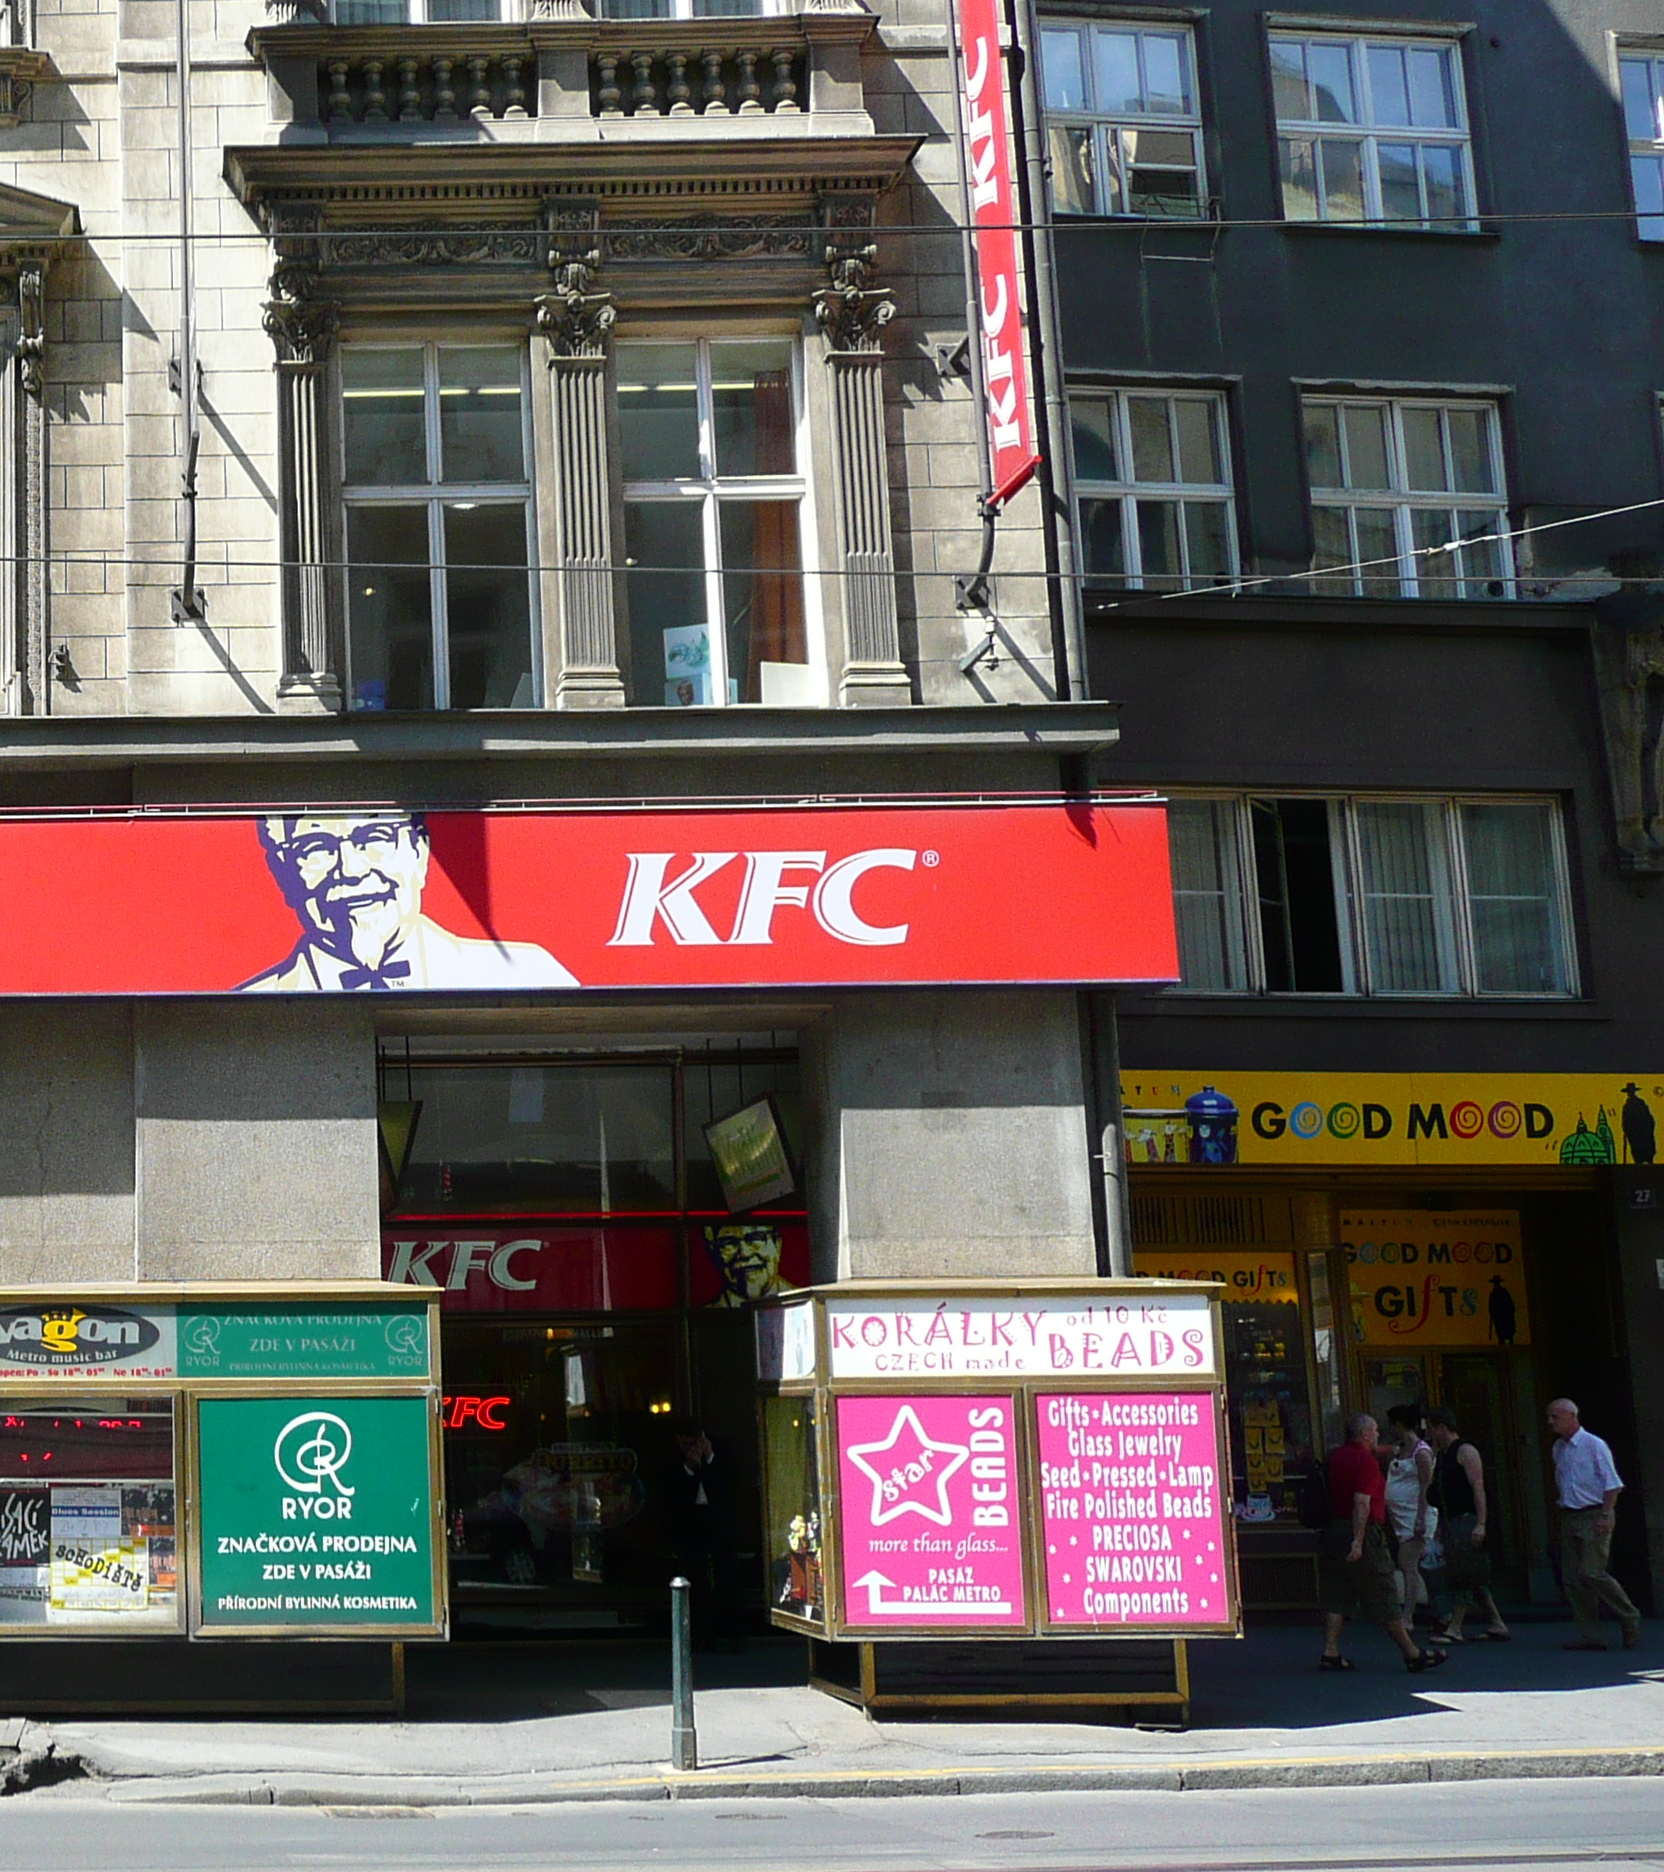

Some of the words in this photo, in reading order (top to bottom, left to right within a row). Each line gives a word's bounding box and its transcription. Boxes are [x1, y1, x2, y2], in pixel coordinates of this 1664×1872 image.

[963, 36, 999, 208] KFC
[980, 273, 1021, 453] KFC
[605, 848, 917, 946] KFC
[1251, 1101, 1393, 1139] GOOD
[1406, 1100, 1554, 1139] MOOD
[1634, 1189, 1651, 1203] 27
[387, 1239, 542, 1291] KFC
[1342, 1241, 1419, 1265] GOOD
[1427, 1241, 1513, 1264] MOOD
[832, 1301, 1048, 1349] KORÁLKY
[1066, 1306, 1093, 1326] od
[1104, 1305, 1130, 1325] 10
[1140, 1303, 1169, 1325] Kč
[7, 1348, 48, 1363] Metro
[51, 1351, 91, 1365] music
[94, 1348, 118, 1363] bar
[249, 1338, 280, 1352] ZDE
[285, 1338, 297, 1352] V
[301, 1335, 356, 1352] PASÁŽI
[1048, 1329, 1205, 1370] BEADS
[26, 1367, 39, 1377] Po
[113, 1367, 127, 1377] Ne
[185, 1356, 220, 1367] RYOR
[387, 1354, 423, 1367] RYOR
[874, 1351, 954, 1372] CZECH
[442, 1396, 511, 1430] FC
[1047, 1399, 1090, 1432] Gifts
[1101, 1397, 1199, 1427] Accessories
[1068, 1430, 1113, 1458] Glass
[1118, 1431, 1183, 1463] Jewelry
[882, 1447, 935, 1502] star
[967, 1406, 1009, 1527] BEADS
[1041, 1461, 1081, 1489] Seed
[1092, 1461, 1156, 1489] Pressed
[1168, 1464, 1214, 1493] Lamp
[52, 1507, 79, 1516] Blues
[80, 1507, 120, 1516] Session
[281, 1496, 352, 1521] RYOR
[1047, 1492, 1079, 1520] Fire
[1084, 1491, 1158, 1520] Polished
[1163, 1491, 1213, 1519] Beads
[217, 1531, 318, 1554] ZNAČKOVÁ
[322, 1535, 418, 1556] PRODEJNA
[868, 1537, 909, 1553] more
[912, 1533, 953, 1553] than
[1092, 1524, 1173, 1552] PRECIOSA
[262, 1564, 295, 1580] ZDE
[299, 1564, 311, 1580] V
[315, 1560, 371, 1580] PASÁŽI
[1085, 1554, 1183, 1583] SWAROVSKI
[217, 1594, 282, 1610] PŘÍRODNÍ
[285, 1594, 341, 1610] BYLINNÁ
[343, 1596, 418, 1610] KOSMETIKA
[953, 1585, 1001, 1602] METRO
[1083, 1587, 1190, 1622] Components
